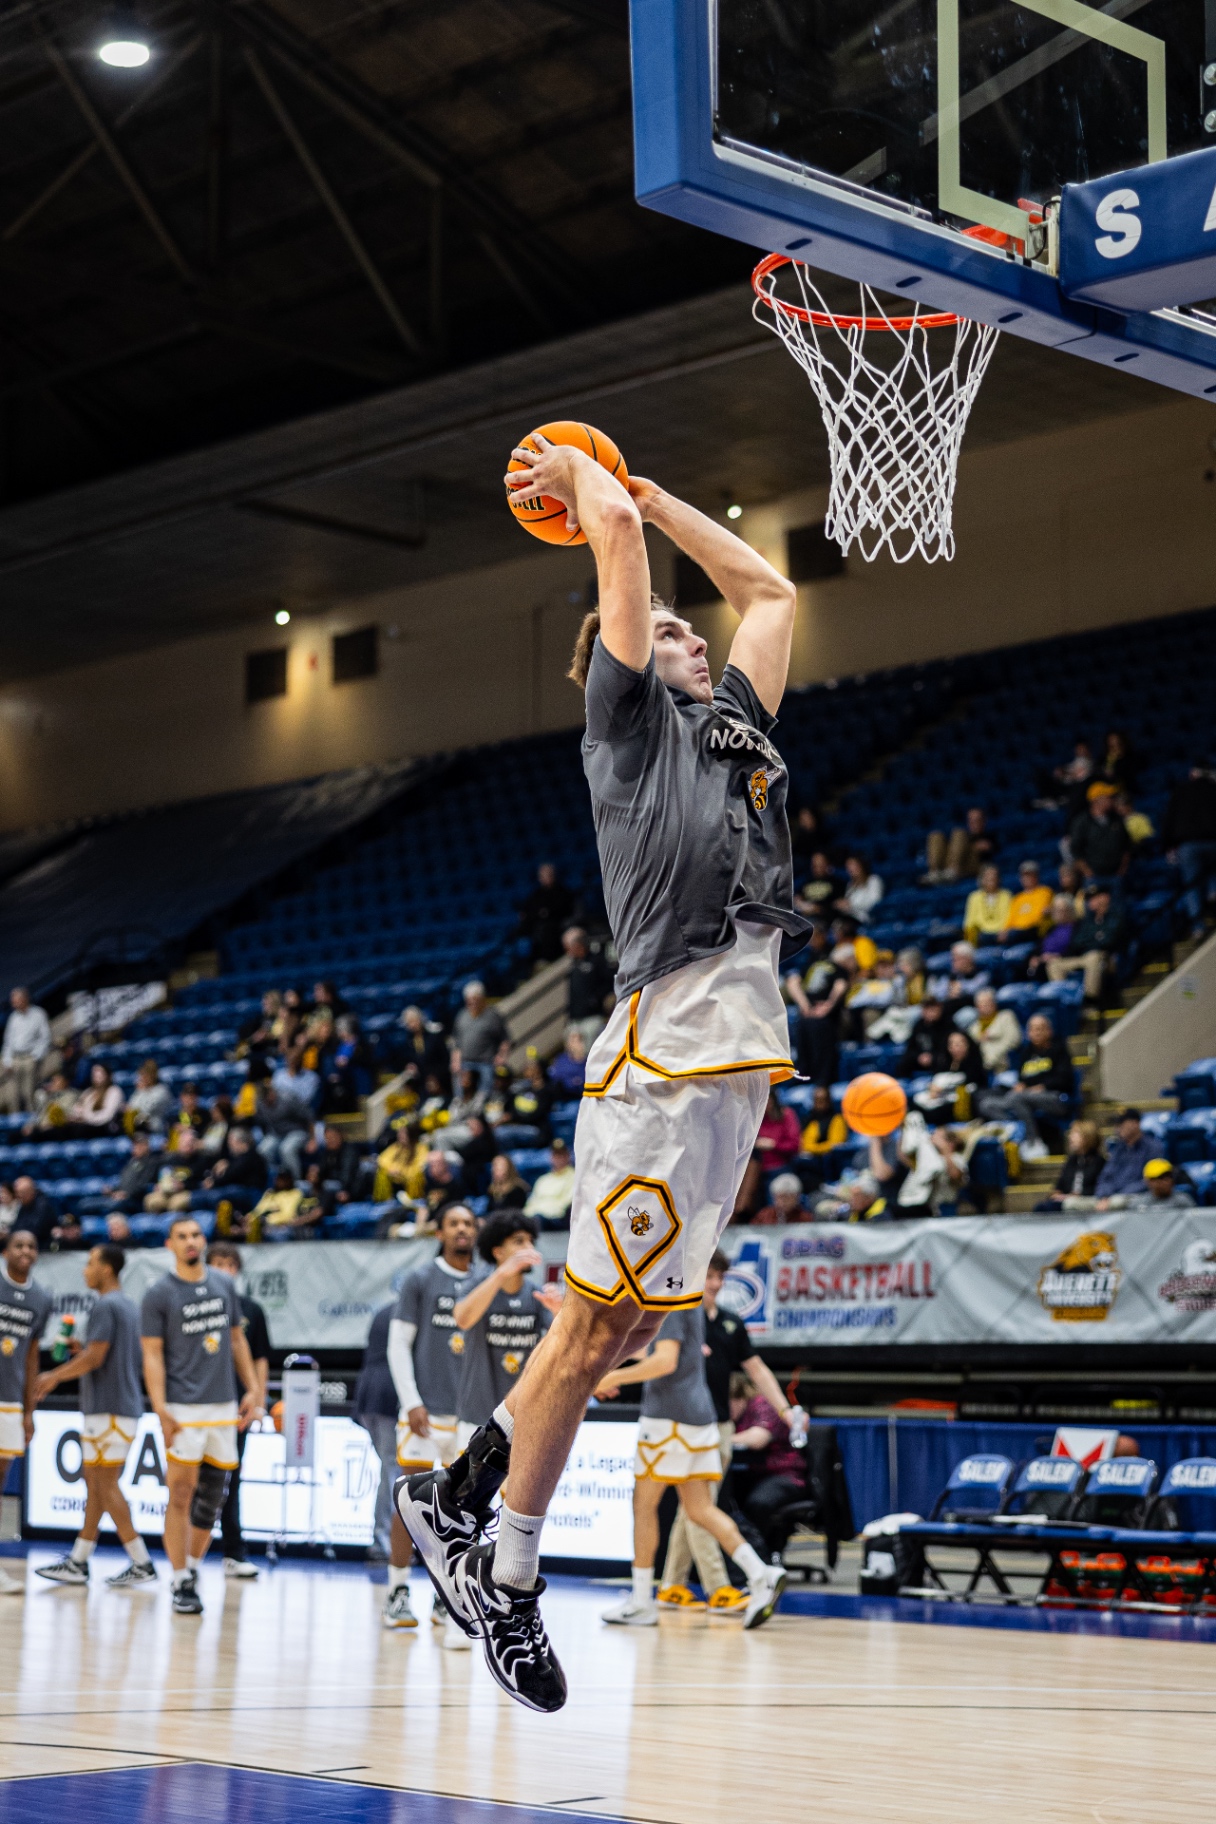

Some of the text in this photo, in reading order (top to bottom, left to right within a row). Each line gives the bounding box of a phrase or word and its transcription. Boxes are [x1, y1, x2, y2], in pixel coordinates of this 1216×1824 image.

[776, 1261, 936, 1302] BASKETBALL
[958, 1460, 1007, 1483] SALEM
[1027, 1461, 1075, 1484] SALEM
[1099, 1463, 1148, 1487] SALEM
